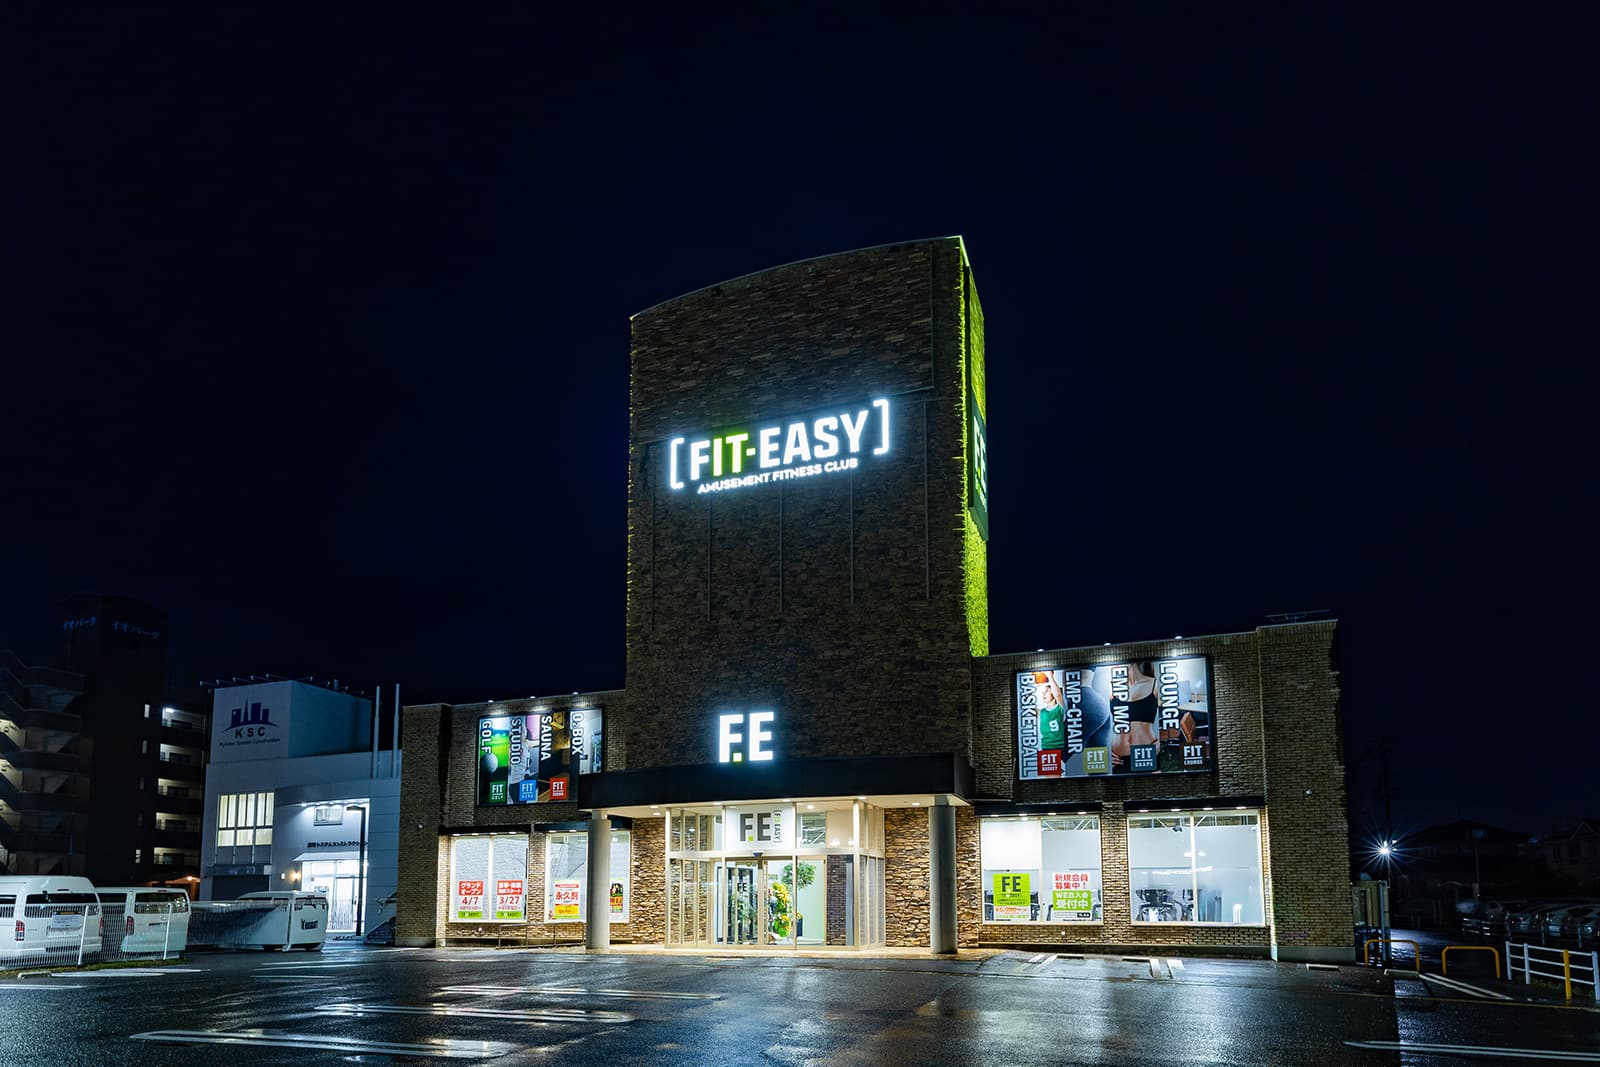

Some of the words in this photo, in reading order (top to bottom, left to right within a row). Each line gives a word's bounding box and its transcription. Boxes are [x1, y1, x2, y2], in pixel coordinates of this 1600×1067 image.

[697, 472, 771, 494] AMUSEMENT
[772, 463, 822, 482] FITNESS
[824, 457, 858, 472] CLUB
[1111, 666, 1129, 702] EMP
[1159, 662, 1180, 731] LOUNGE
[1065, 671, 1084, 754] EMP-CHAIR
[1020, 674, 1038, 778] BASKETBALL
[481, 720, 492, 754] GOLF
[511, 718, 522, 765] STUDIO
[540, 715, 552, 761] SAUNA
[1087, 750, 1105, 762] FIT
[1134, 748, 1153, 759] FIT
[1184, 745, 1203, 757] FIT
[1041, 754, 1057, 764] FIT
[492, 784, 504, 793] FIT
[521, 783, 534, 792] FIT
[552, 781, 564, 790] FIT
[462, 896, 479, 904] 4/7
[499, 896, 520, 904] 3/27
[1056, 899, 1088, 909] 受付中
